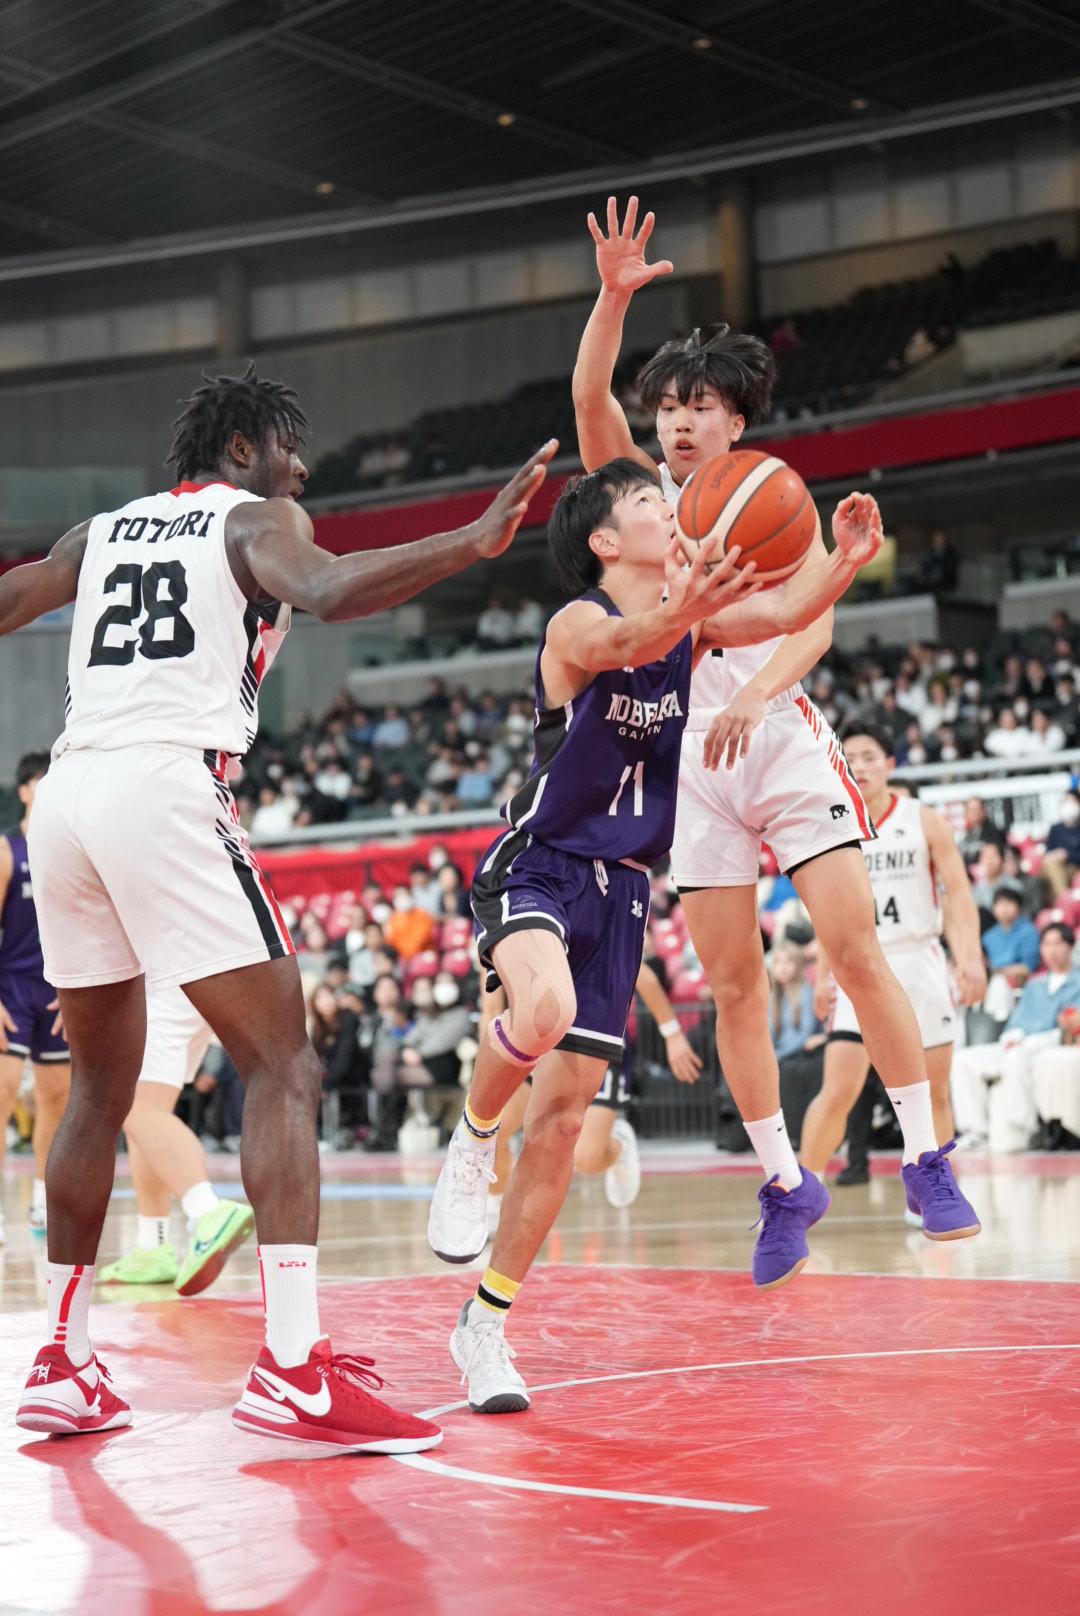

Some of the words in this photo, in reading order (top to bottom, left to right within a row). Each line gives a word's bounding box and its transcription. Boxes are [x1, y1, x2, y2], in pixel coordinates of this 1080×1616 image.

[108, 510, 215, 543] TOTORI
[87, 560, 195, 668] 28
[608, 760, 645, 817] 11
